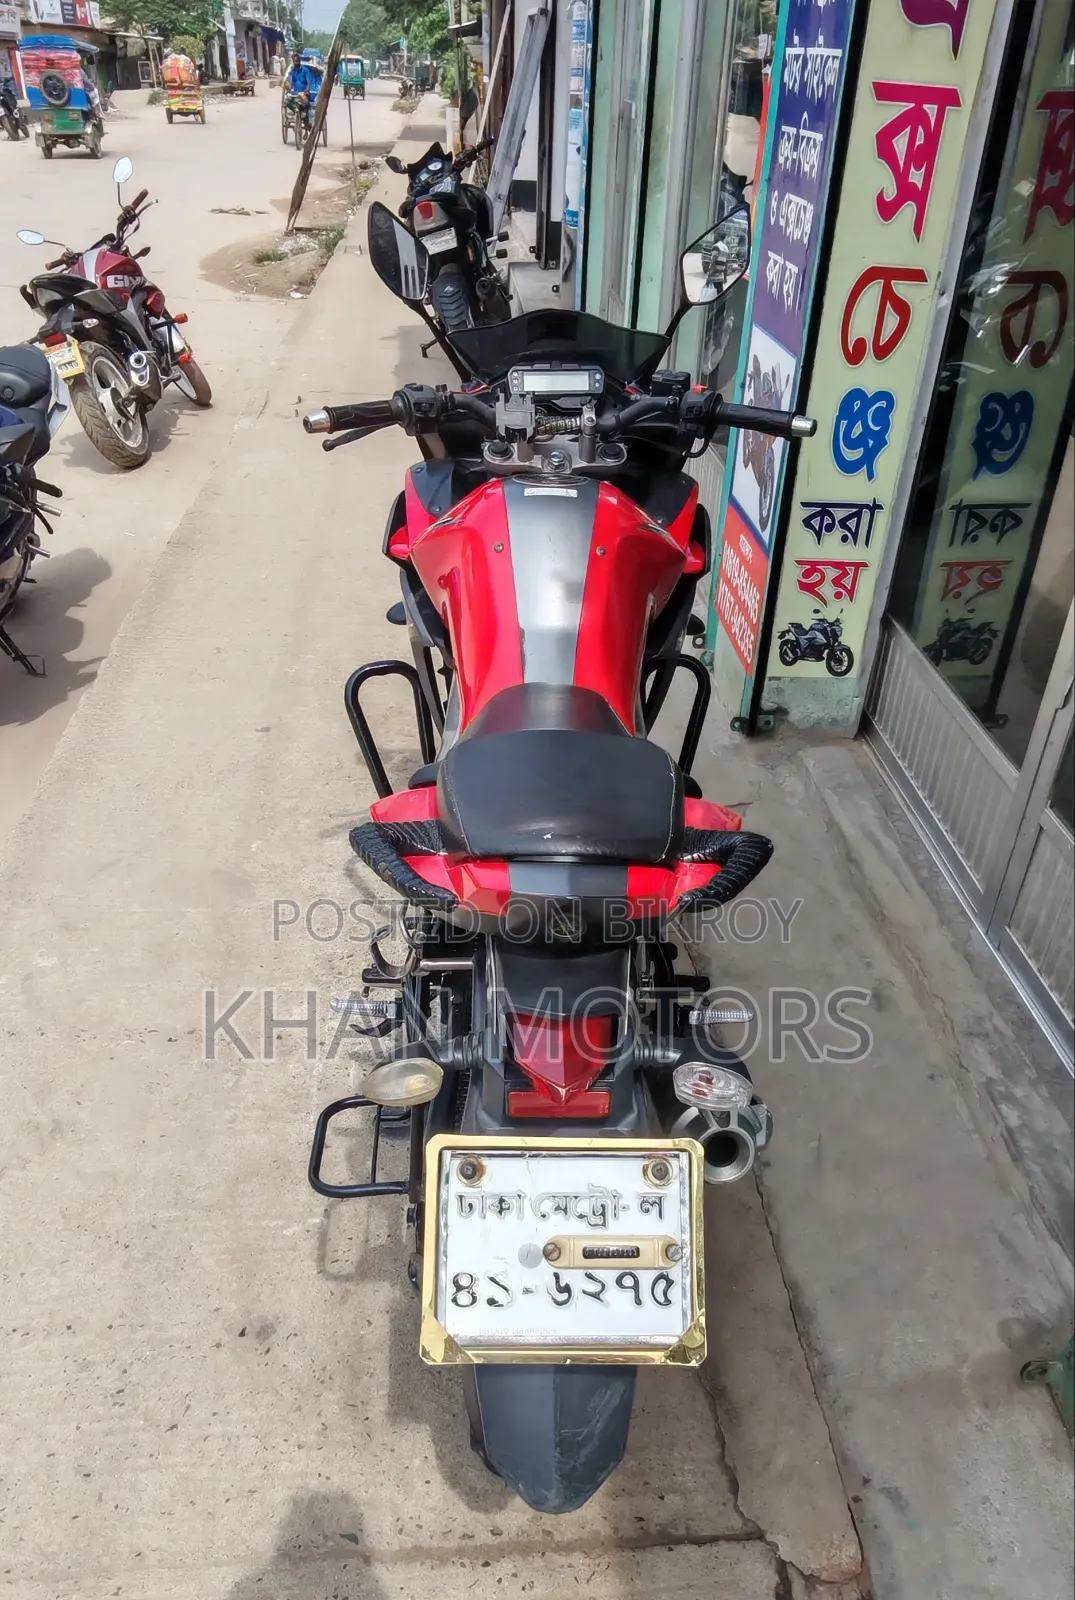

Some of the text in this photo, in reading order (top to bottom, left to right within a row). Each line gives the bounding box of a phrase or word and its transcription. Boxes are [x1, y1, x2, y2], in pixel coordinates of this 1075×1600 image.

[766, 250, 784, 300] করা
[800, 497, 884, 549] করা
[794, 559, 870, 608] হয়
[456, 1190, 527, 1220] ঢাকা
